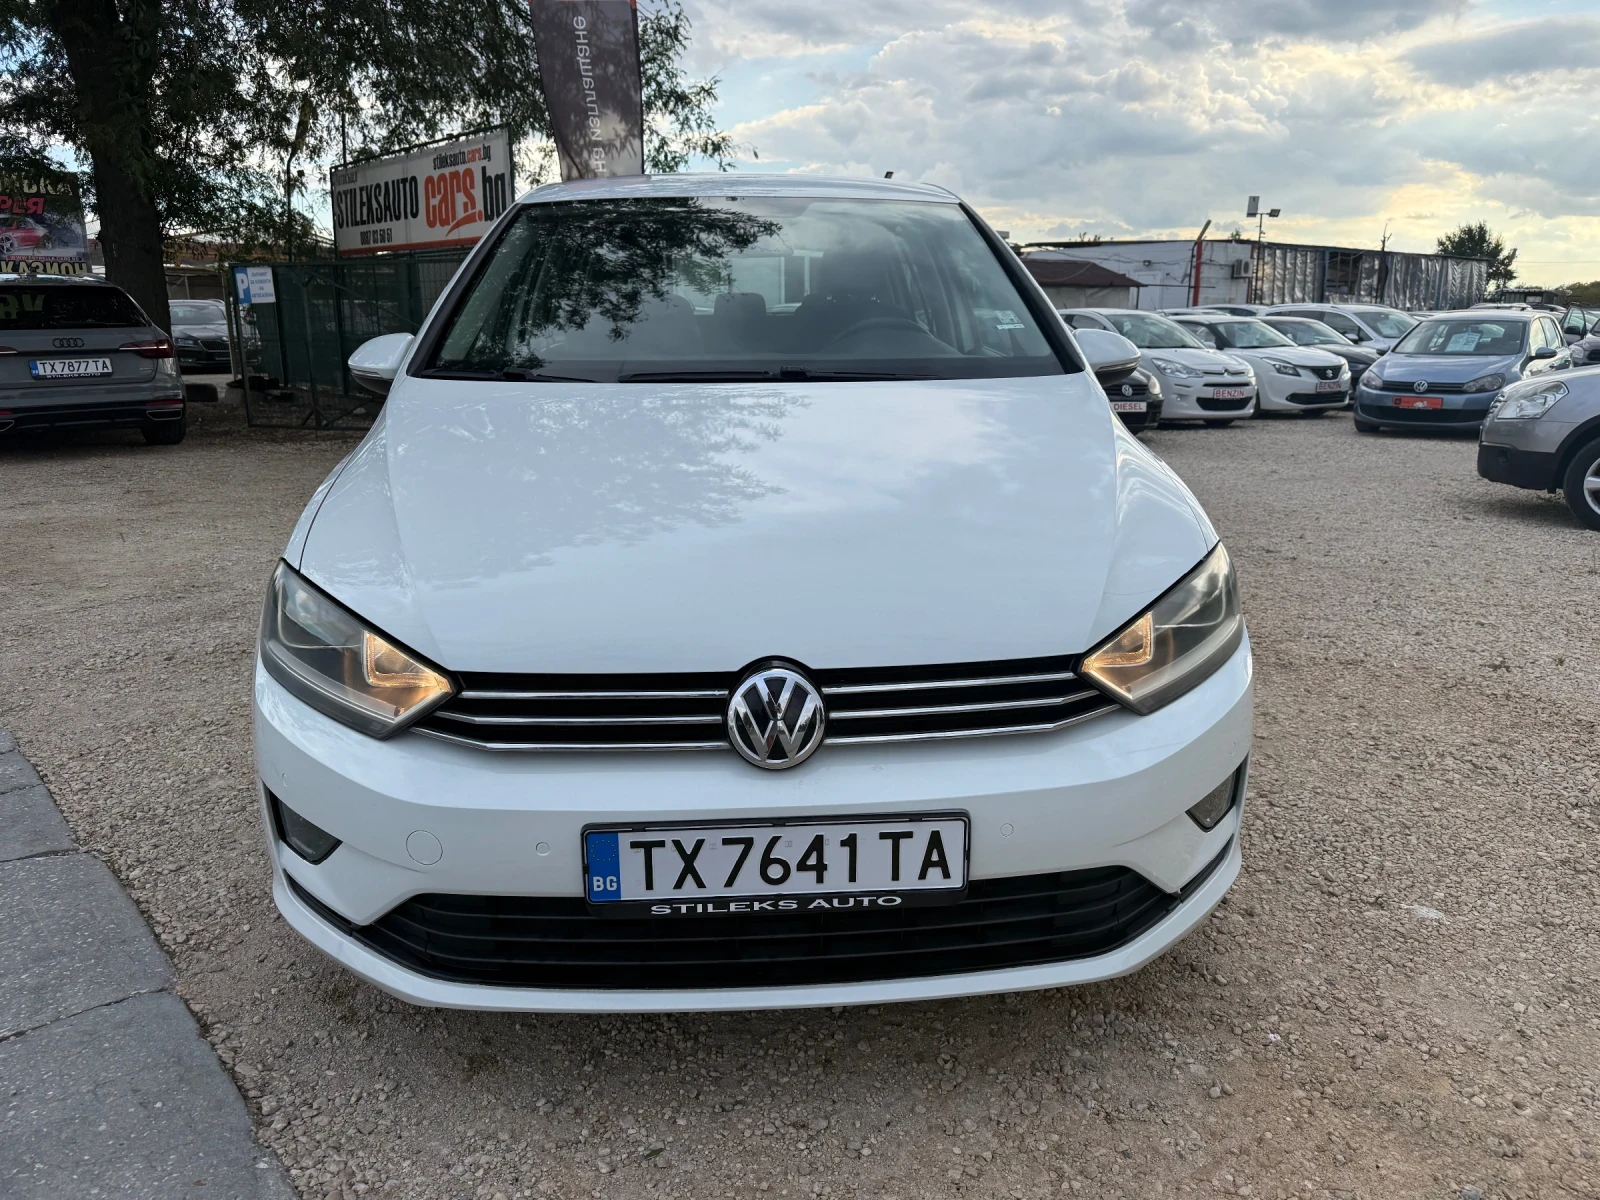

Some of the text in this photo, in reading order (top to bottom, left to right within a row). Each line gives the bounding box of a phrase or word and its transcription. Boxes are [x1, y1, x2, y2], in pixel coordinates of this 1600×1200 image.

[336, 175, 419, 230] STILEKSAUTO
[39, 359, 110, 374] TX 7877 TA
[1215, 388, 1245, 398] BENZIN
[1113, 402, 1143, 411] DIESEL
[629, 829, 952, 891] TX 7641 TA
[592, 875, 618, 892] BG
[650, 894, 902, 915] STILEKS AUTO
